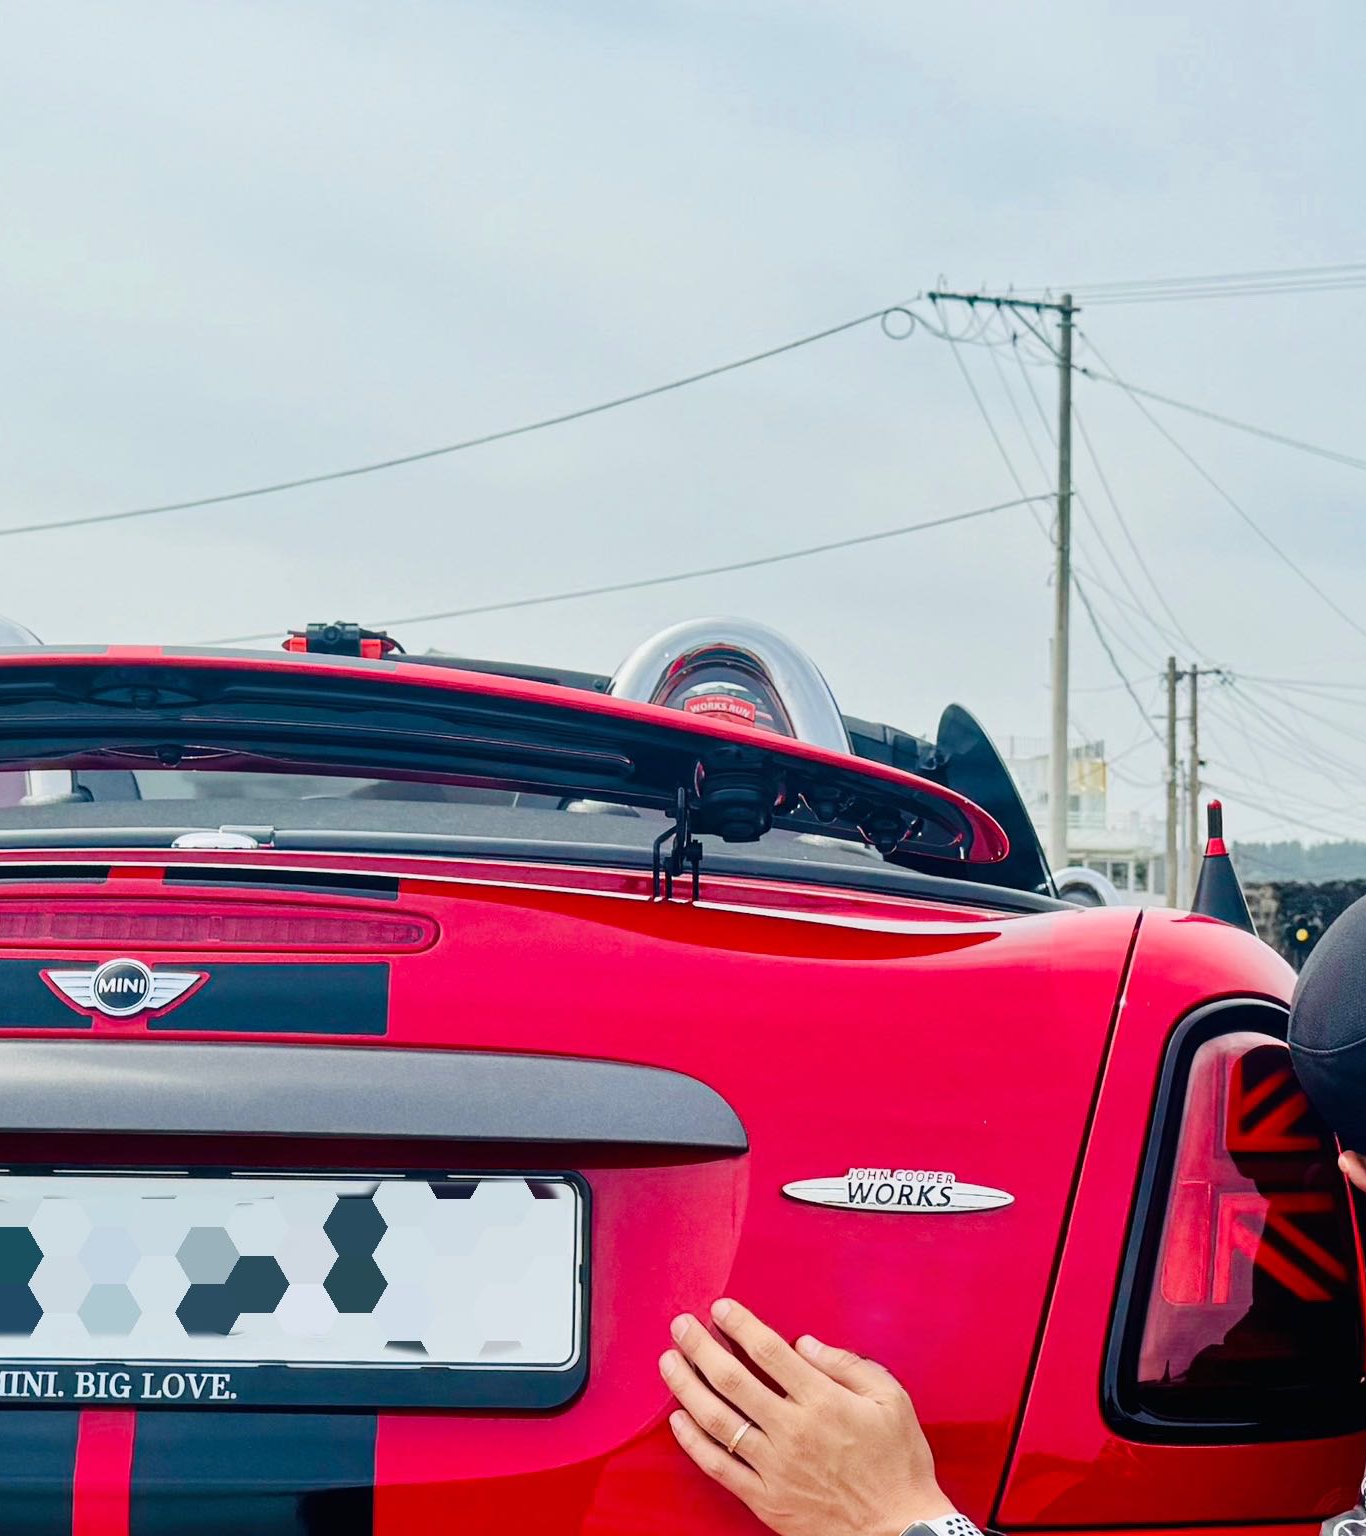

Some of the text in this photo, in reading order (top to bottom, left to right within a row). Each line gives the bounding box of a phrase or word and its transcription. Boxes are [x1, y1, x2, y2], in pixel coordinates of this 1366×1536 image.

[689, 701, 752, 718] WORKS RUN
[98, 976, 146, 995] MINI
[847, 1169, 954, 1185] JOHN COOPER
[847, 1181, 954, 1208] WORKS
[73, 1371, 133, 1399] BIG
[140, 1372, 238, 1401] LOVE.
